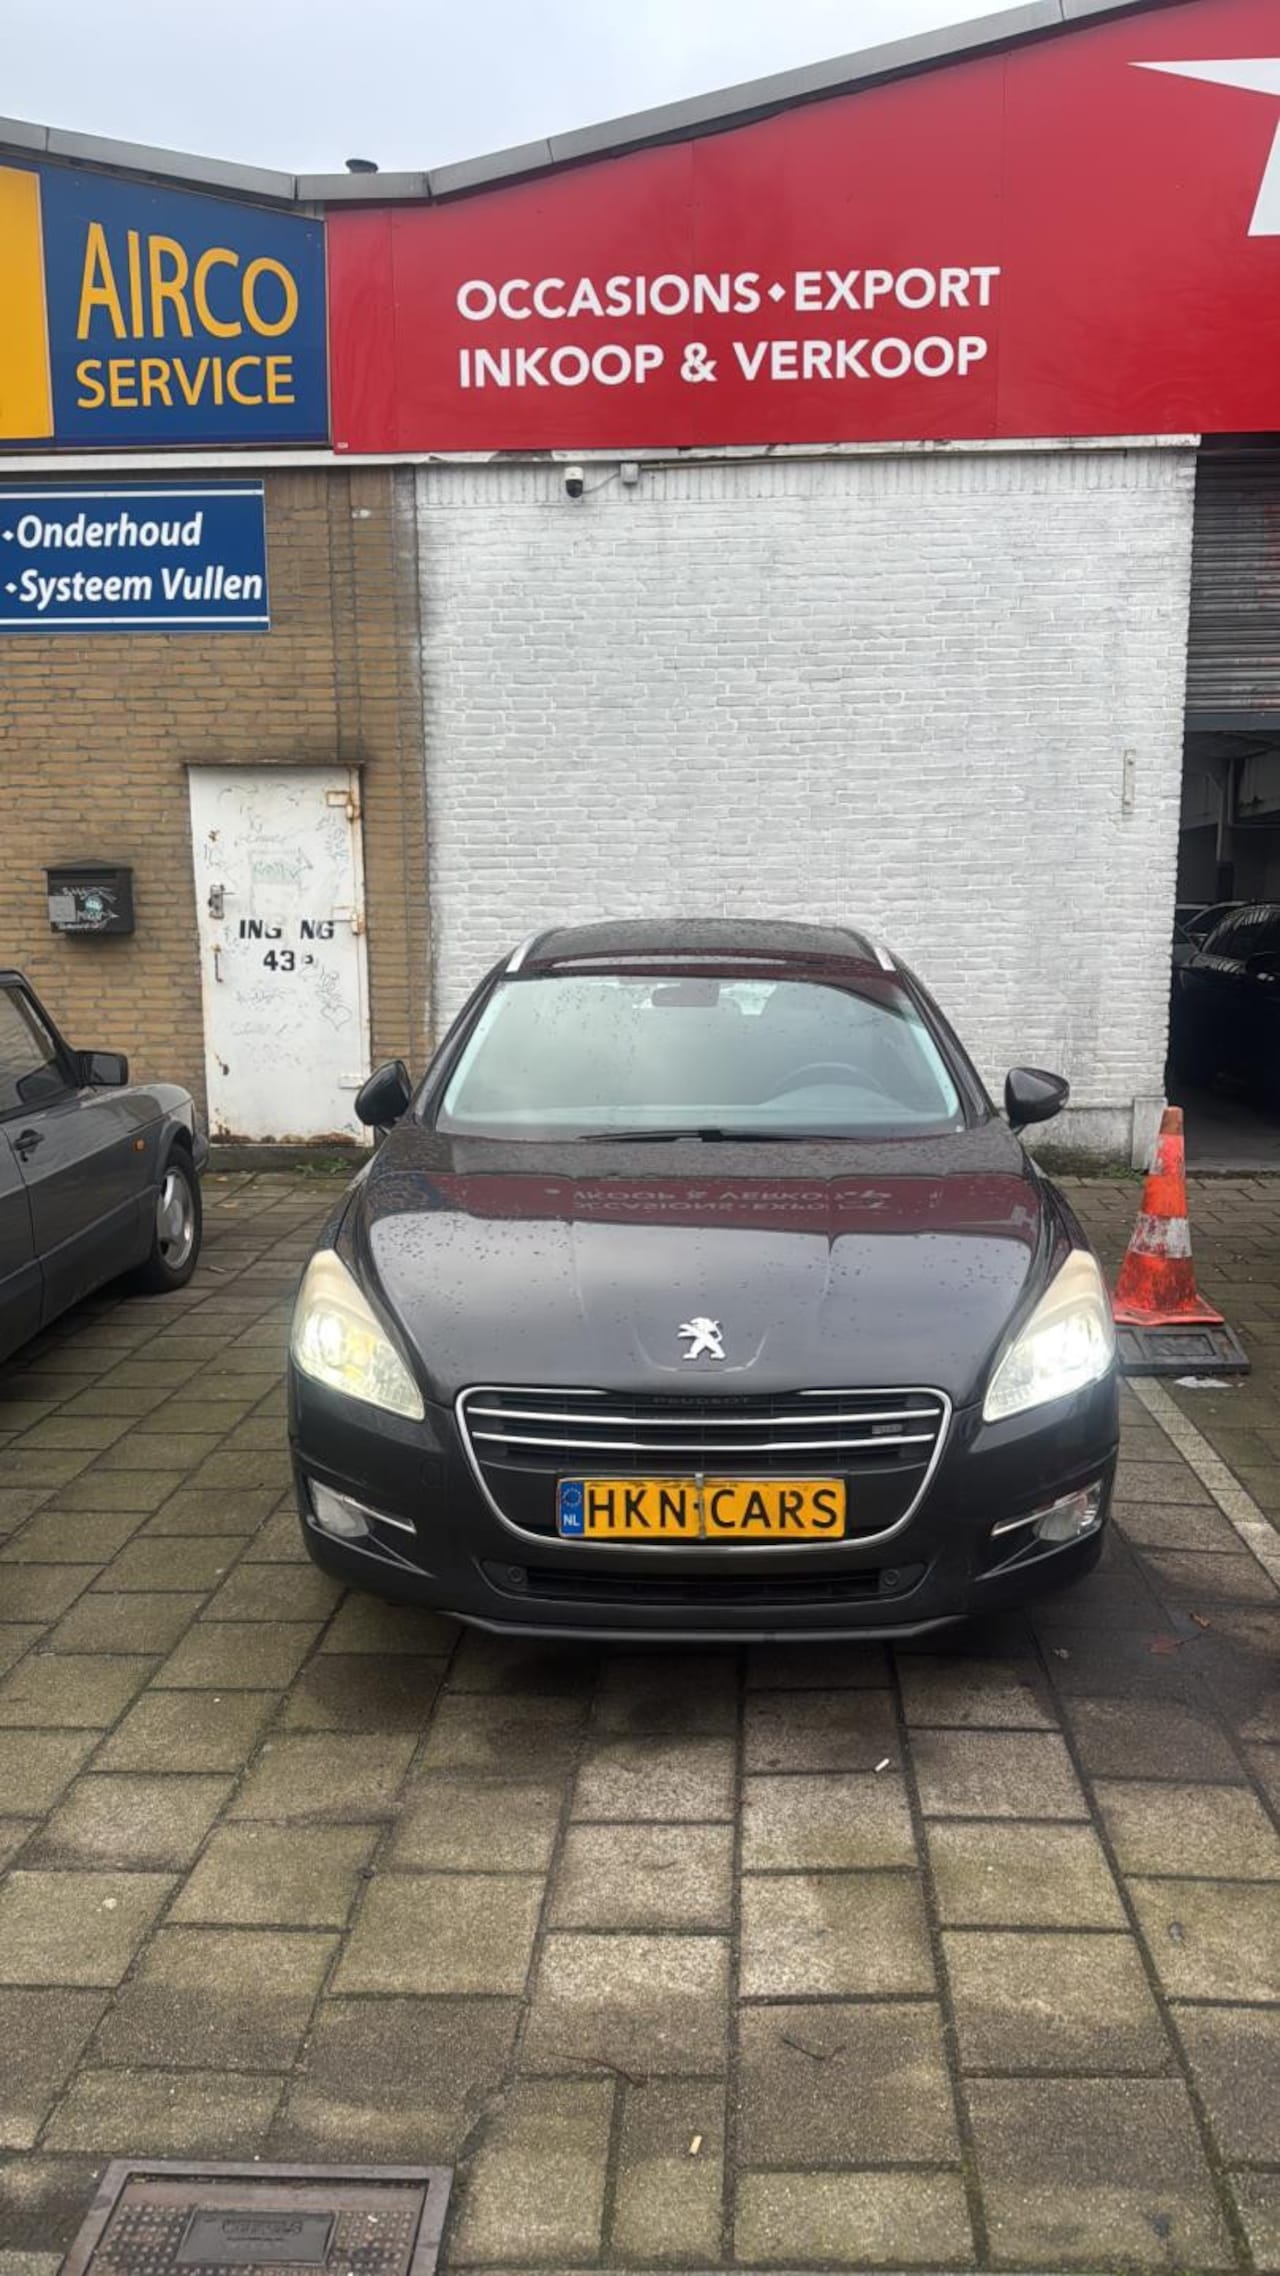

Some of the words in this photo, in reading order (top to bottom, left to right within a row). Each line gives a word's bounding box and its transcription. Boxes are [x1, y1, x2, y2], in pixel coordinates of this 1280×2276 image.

[77, 222, 298, 340] AIRCO
[457, 272, 761, 321] OCCASIONS
[795, 266, 1001, 311] EXPORT
[76, 355, 295, 408] SERVICE
[459, 344, 664, 388] INKOOP
[680, 342, 717, 383] &
[732, 335, 988, 381] VERKOOP
[17, 511, 203, 548] Onderhoud
[19, 569, 153, 611] Systeem
[161, 565, 262, 601] Vullen
[562, 1515, 581, 1527] NL
[710, 1488, 838, 1529] CARS
